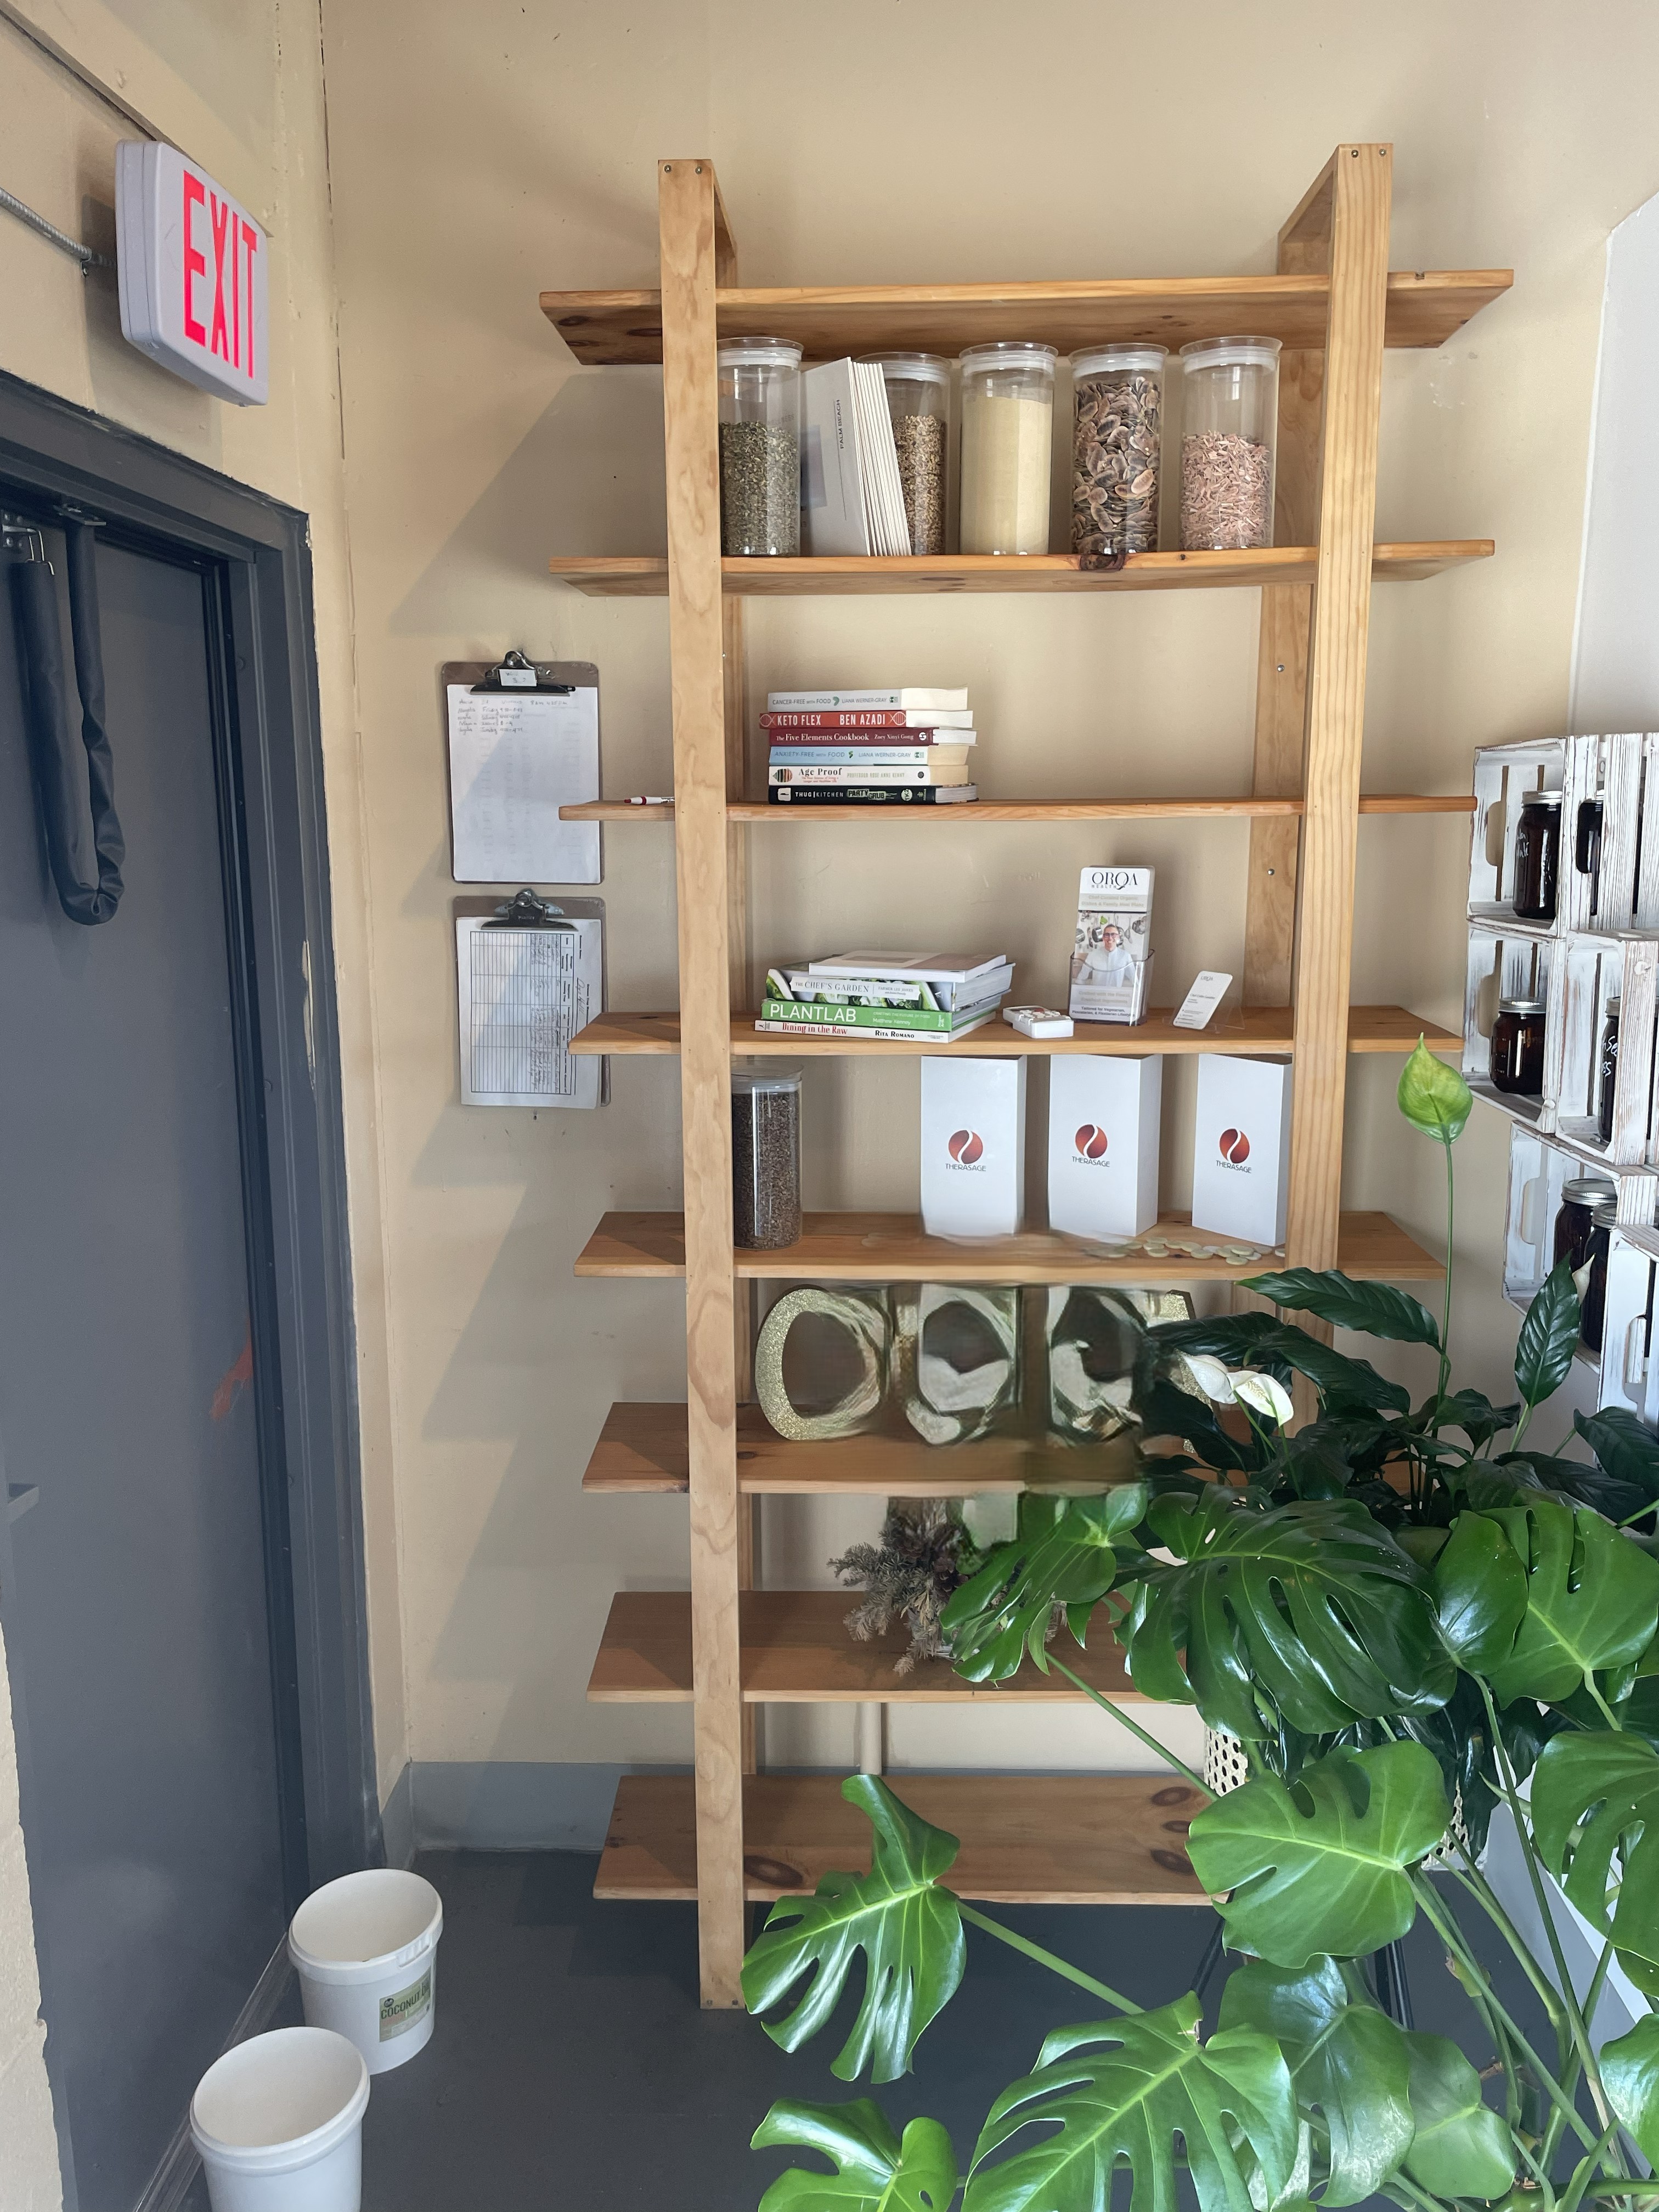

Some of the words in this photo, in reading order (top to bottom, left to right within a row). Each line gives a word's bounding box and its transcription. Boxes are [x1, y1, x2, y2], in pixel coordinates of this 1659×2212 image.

[183, 170, 258, 379] EXIT
[777, 714, 798, 726] KETO
[801, 714, 821, 726] FLEX
[839, 714, 856, 725] BEN
[860, 714, 885, 725] AZADI
[834, 732, 870, 741] Cookbook
[799, 768, 814, 777] Age
[817, 768, 843, 776] Proof
[1092, 871, 1138, 890] ORQA
[804, 981, 833, 990] CHEF'S
[834, 983, 870, 992] GARDEN
[770, 1003, 856, 1023] PLANTLAB
[782, 1022, 806, 1034] Dining
[808, 1024, 815, 1033] in
[817, 1024, 830, 1034] the
[832, 1025, 848, 1035] Raw
[945, 1163, 986, 1172] THERASAGE
[1071, 1155, 1110, 1168] THERASAGE
[1216, 1160, 1252, 1174] THERASAGE
[381, 1990, 420, 2019] COCONUT
